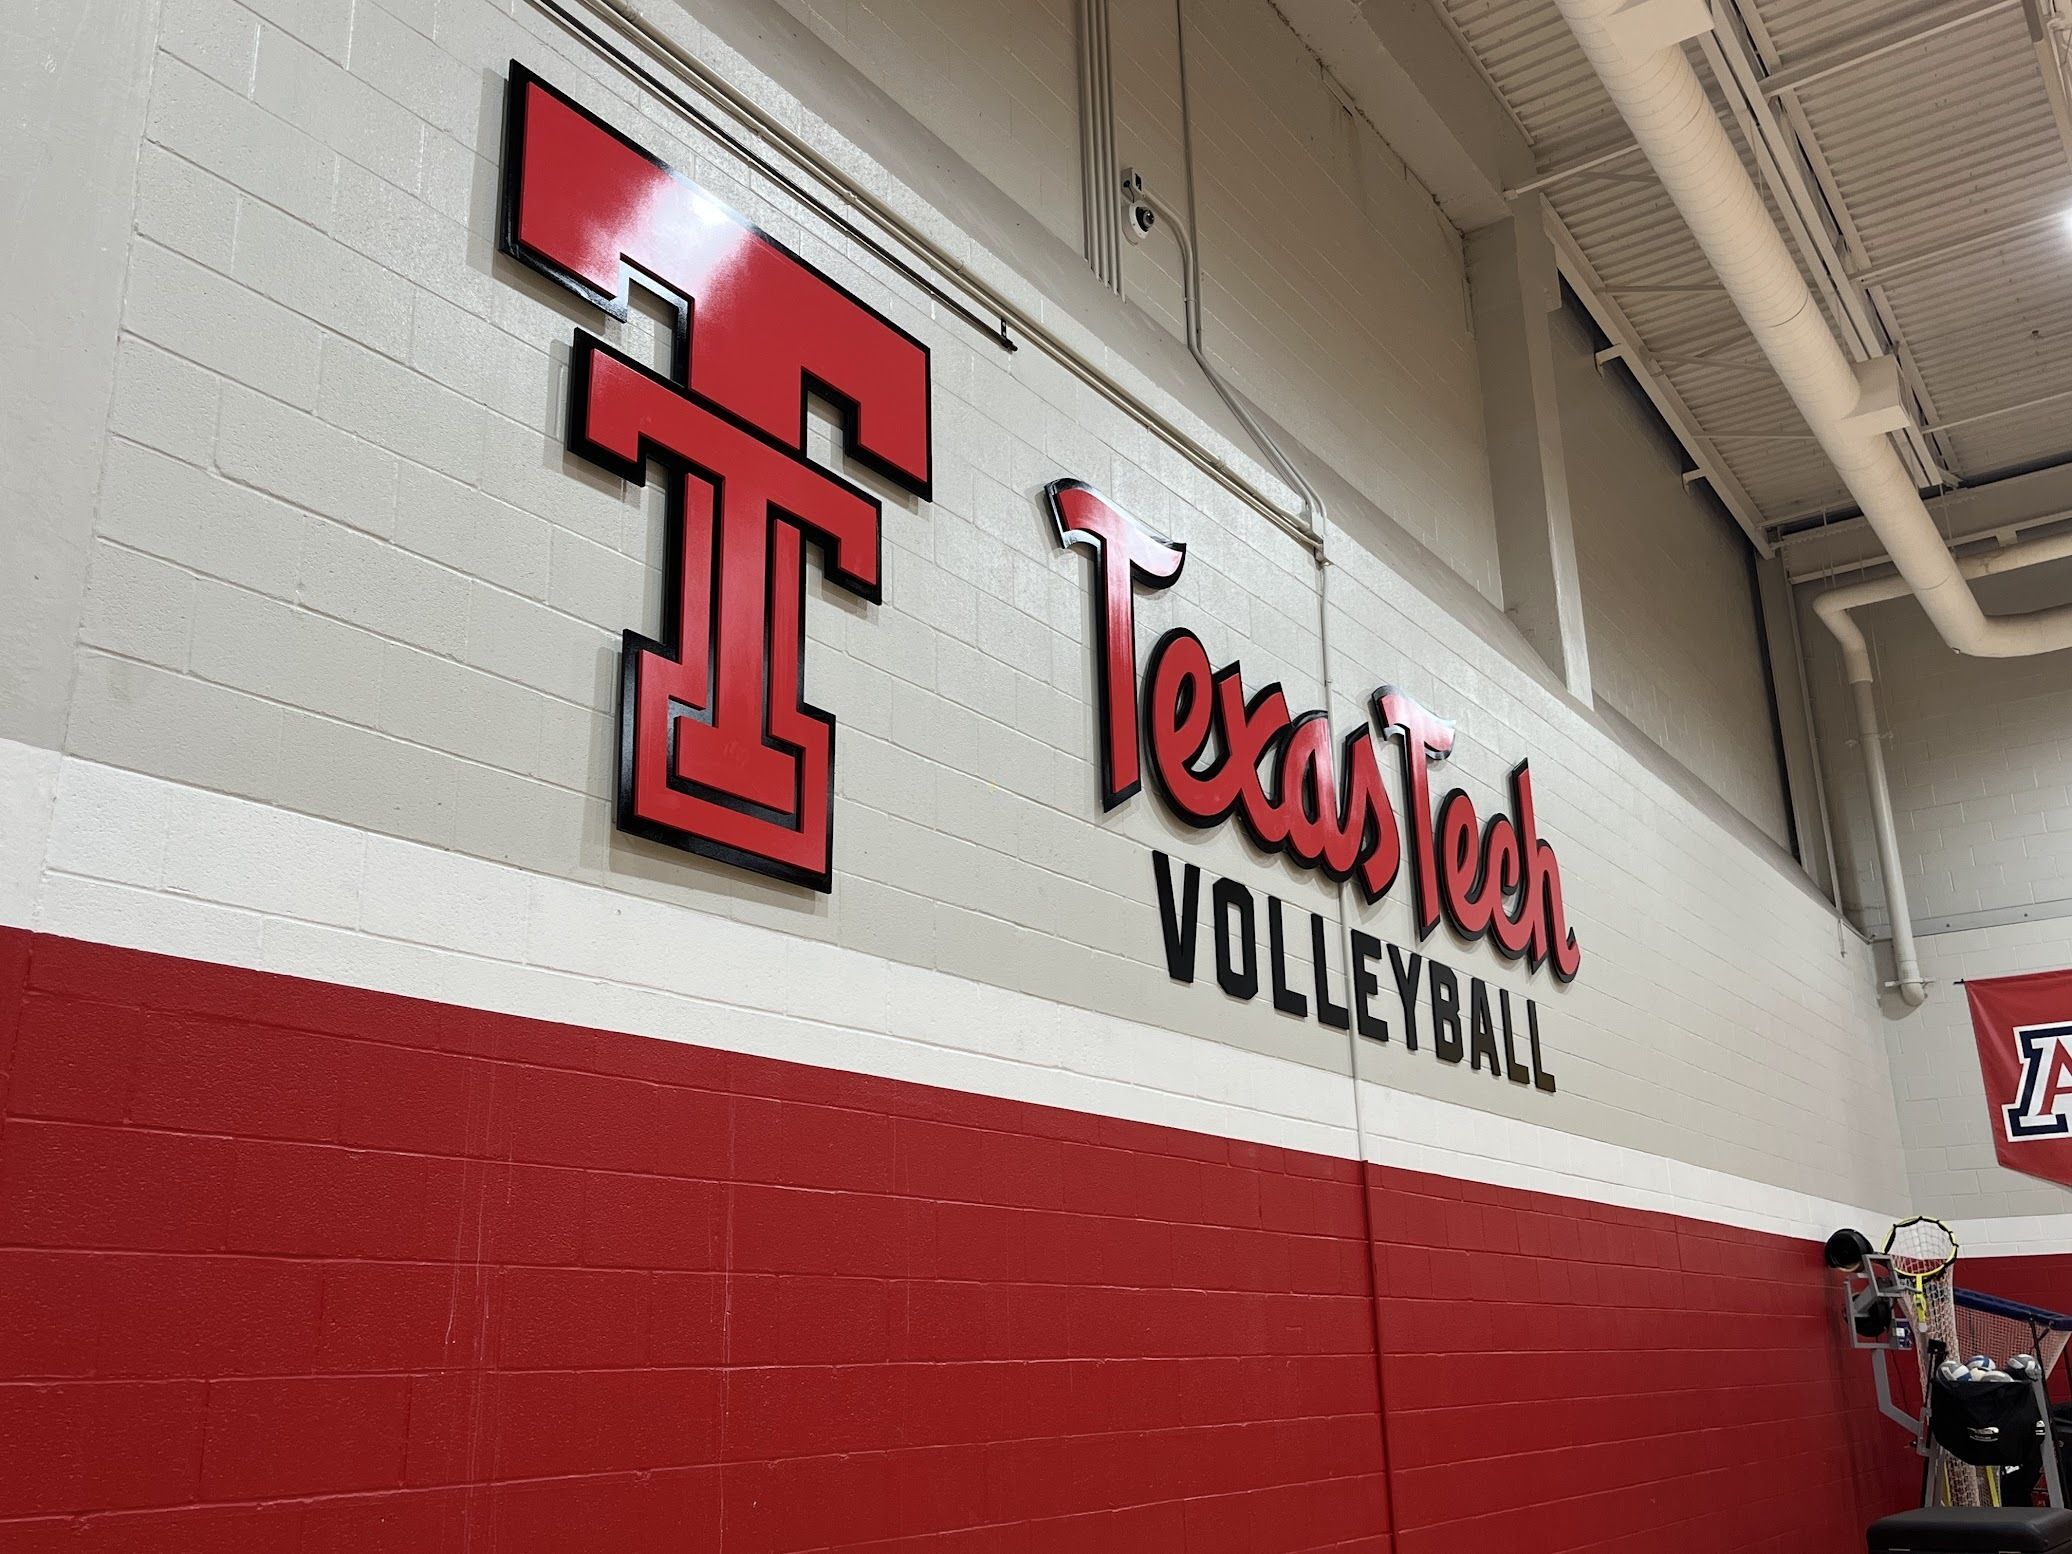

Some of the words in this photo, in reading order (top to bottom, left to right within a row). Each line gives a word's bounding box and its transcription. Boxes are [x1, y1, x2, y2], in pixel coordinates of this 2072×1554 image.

[1044, 478, 1401, 903] Texas
[1372, 686, 1580, 983] Tech
[1152, 850, 1556, 1092] VOLLEYBALL
